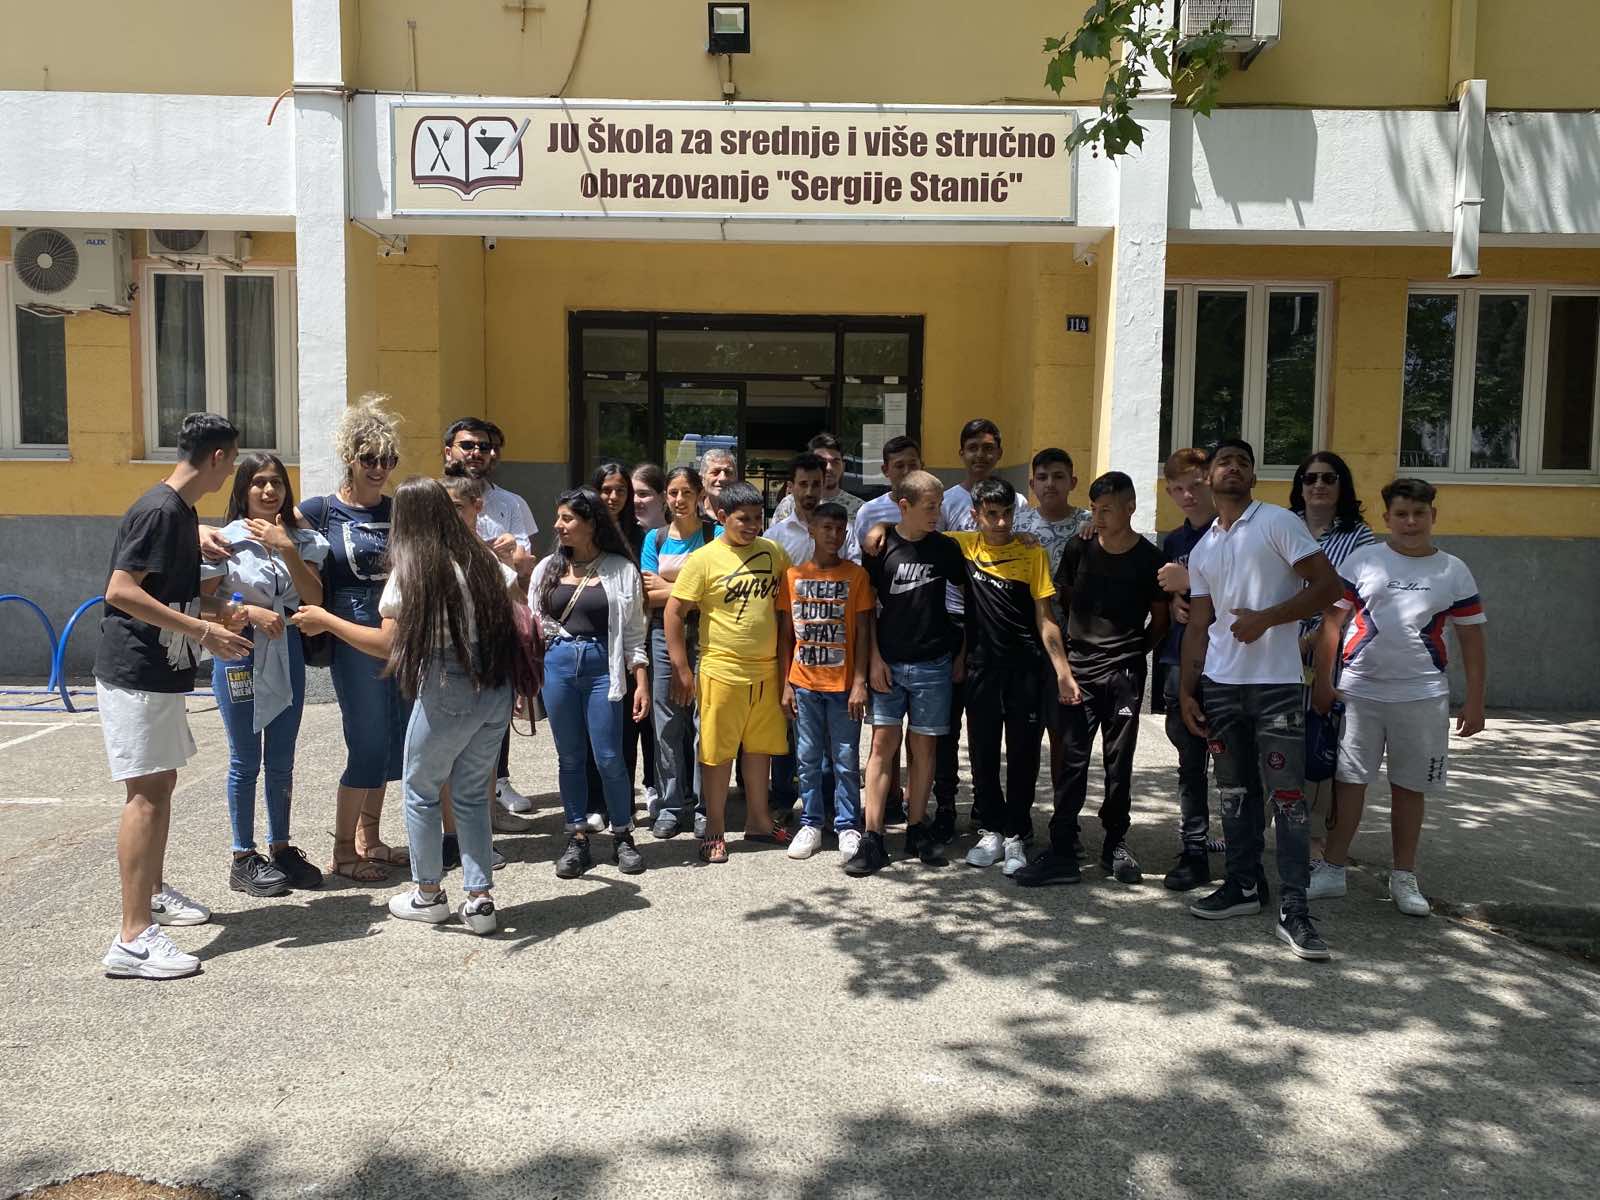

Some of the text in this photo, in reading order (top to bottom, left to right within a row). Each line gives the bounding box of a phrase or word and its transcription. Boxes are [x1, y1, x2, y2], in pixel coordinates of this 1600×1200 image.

[547, 117, 1056, 159] JU Škola za srednje i više stručno
[581, 168, 1023, 206] obrazovanje "Sergije Stanić"
[895, 563, 934, 581] NIKE
[804, 580, 845, 599] KEEP
[801, 600, 836, 619] COOL
[802, 623, 839, 642] STAY
